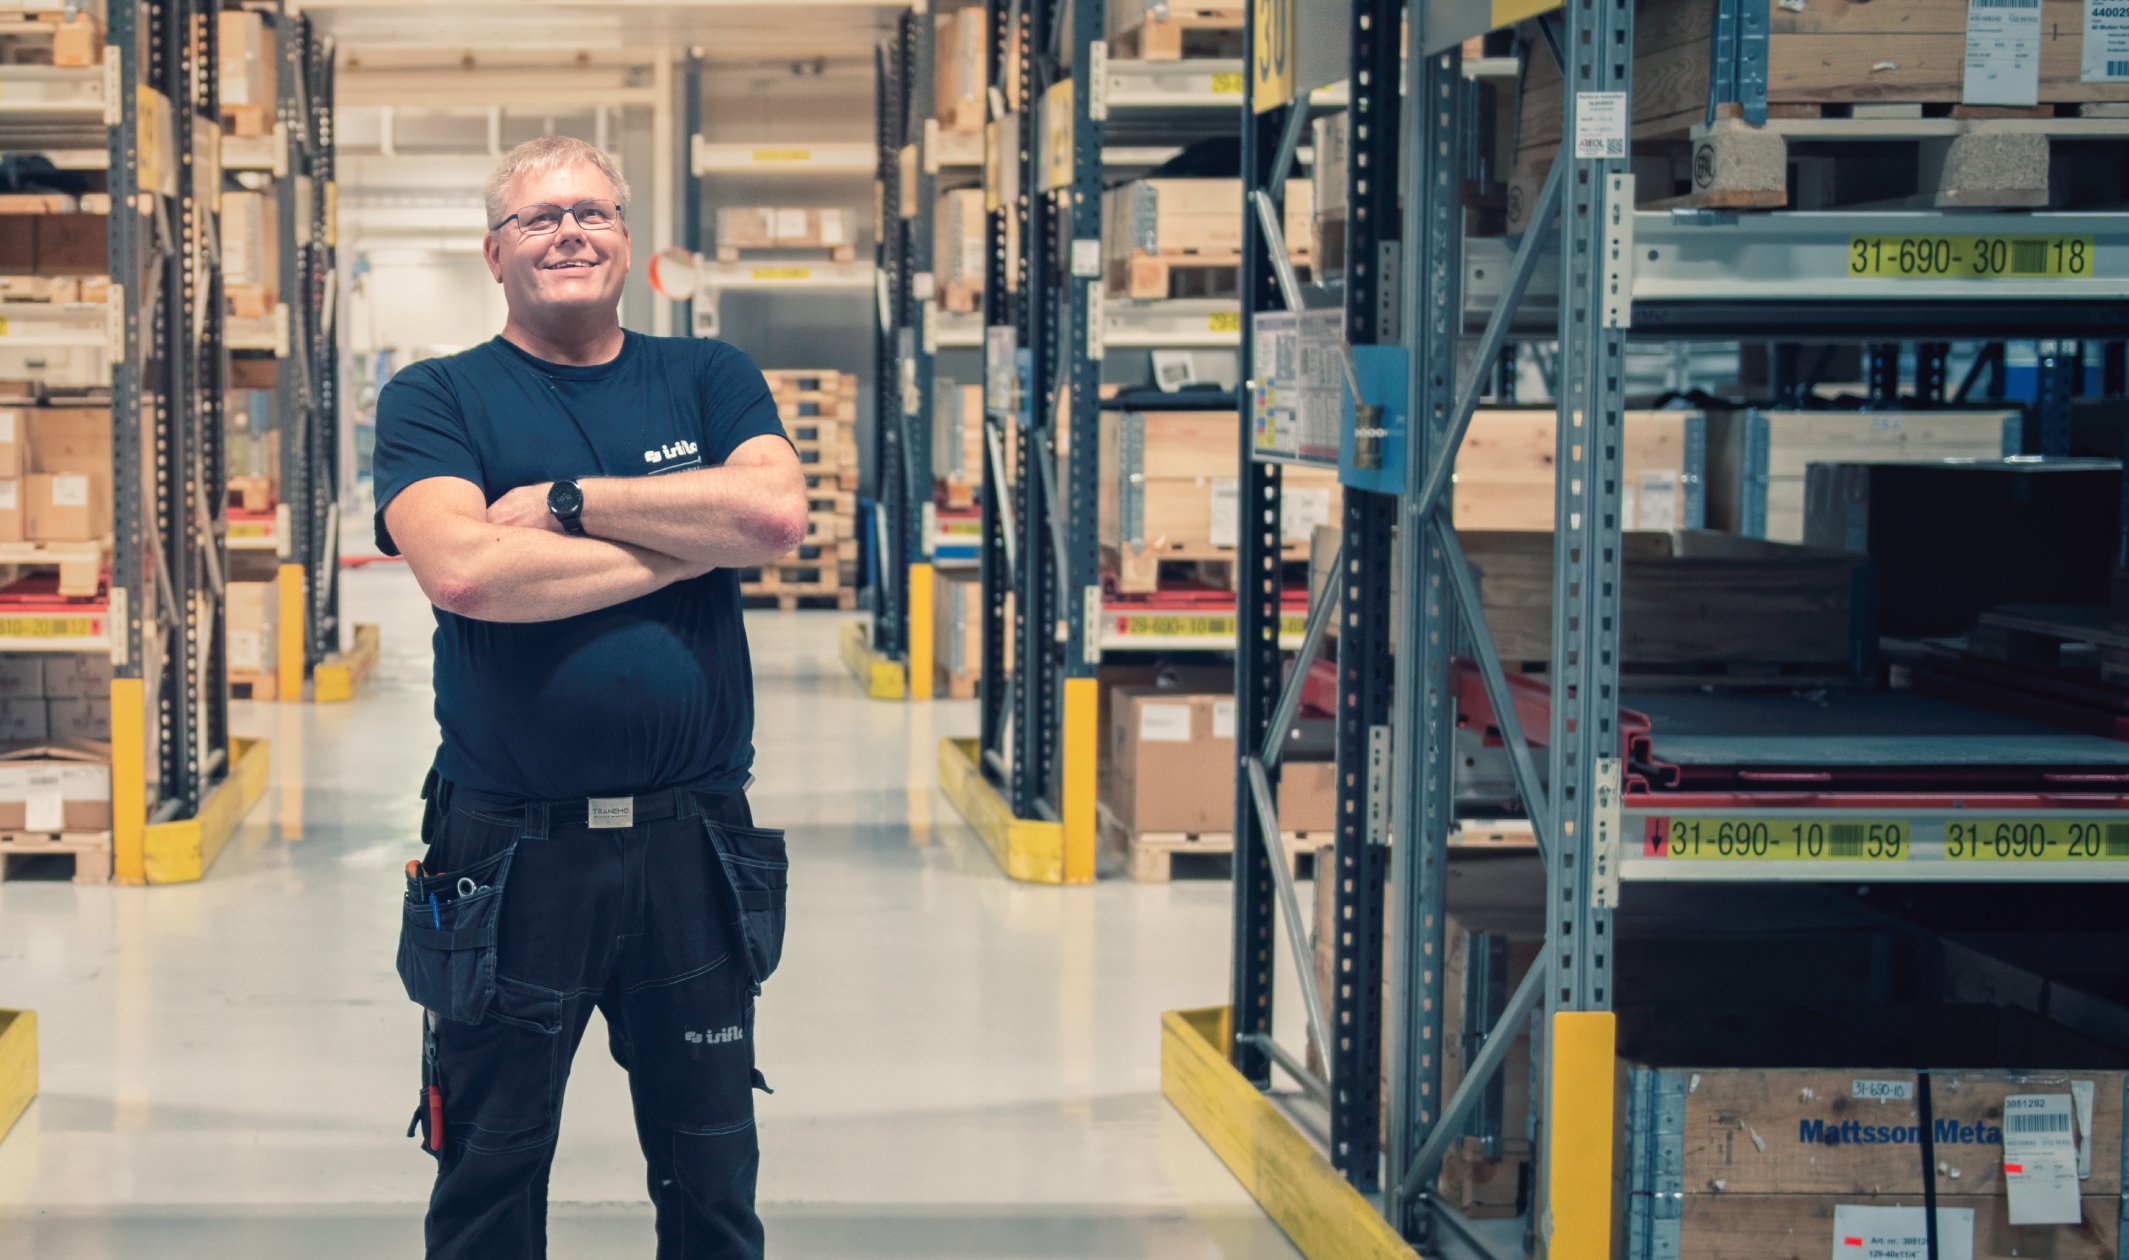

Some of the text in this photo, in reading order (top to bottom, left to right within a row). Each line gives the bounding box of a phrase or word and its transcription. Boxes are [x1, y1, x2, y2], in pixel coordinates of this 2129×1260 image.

[1259, 0, 1286, 82] 30
[1852, 239, 2085, 273] 31-690- 30 18
[1672, 821, 1901, 858] 31-690- 10 59
[1949, 823, 2101, 857] 31-690- 20
[1800, 1119, 1921, 1144] Mattsson
